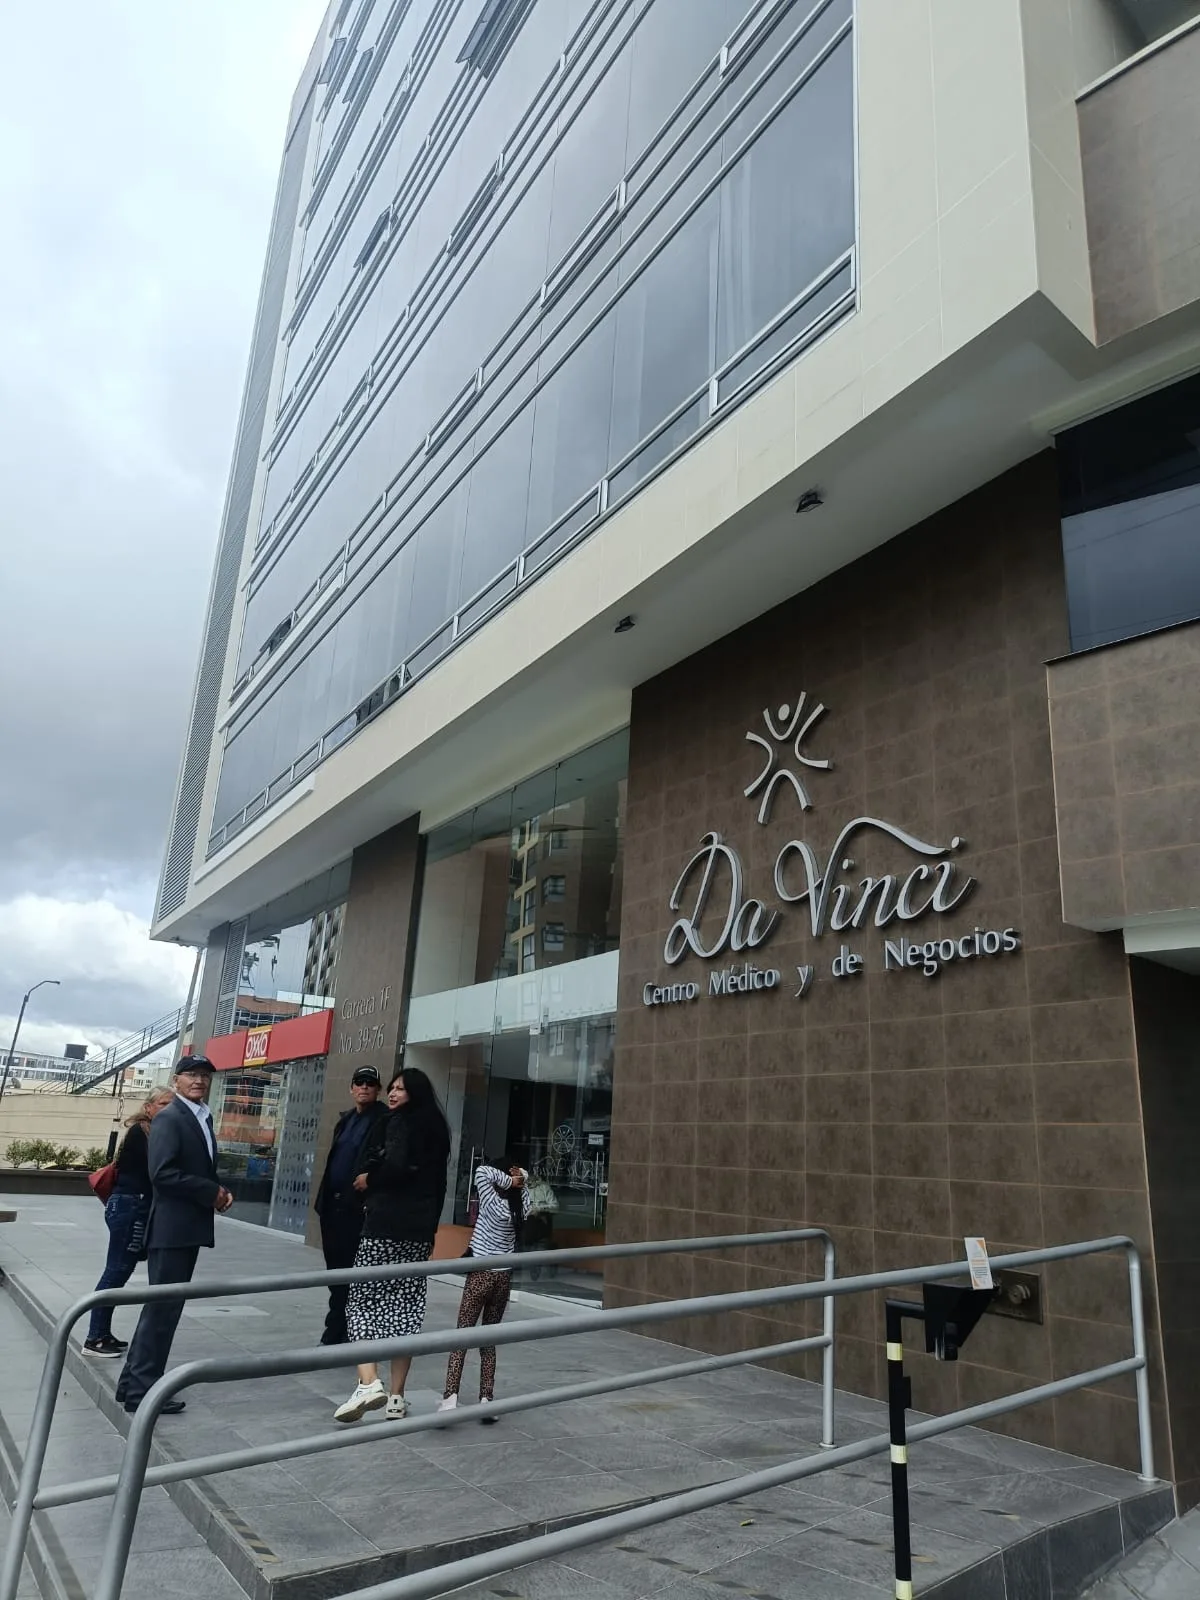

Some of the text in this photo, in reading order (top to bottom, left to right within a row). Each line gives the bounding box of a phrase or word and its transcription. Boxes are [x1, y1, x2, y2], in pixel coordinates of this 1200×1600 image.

[664, 816, 977, 965] Da Vinci
[643, 926, 1022, 1006] Centro Médico y de Negocios
[341, 996, 375, 1019] Carrera
[245, 1032, 269, 1059] OXXO
